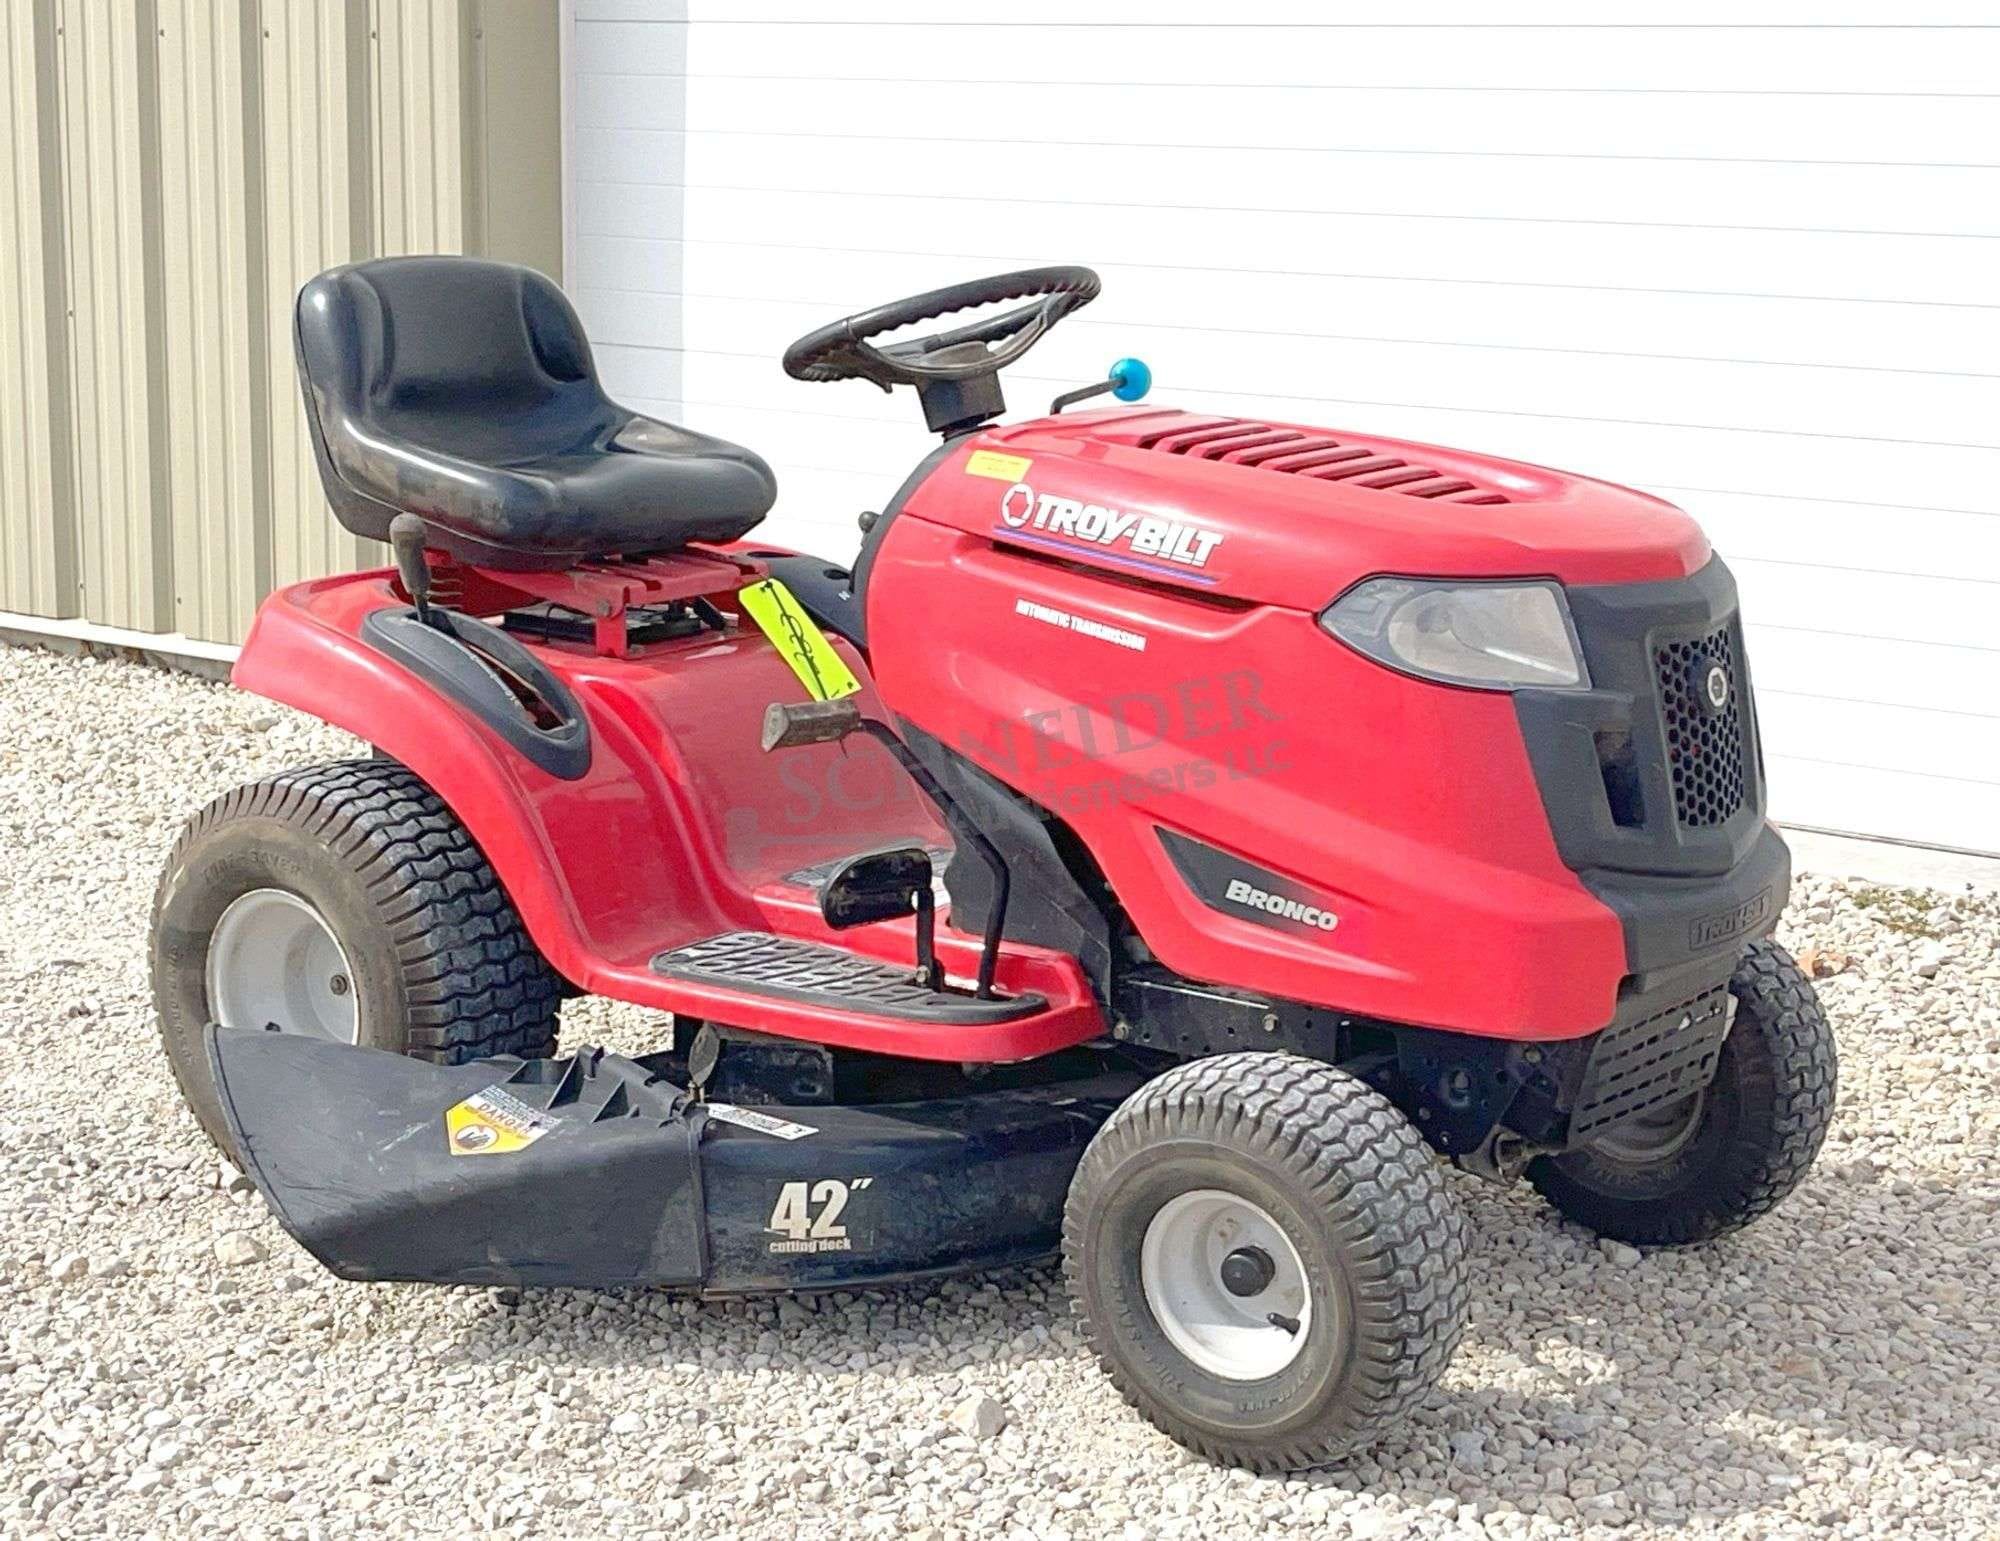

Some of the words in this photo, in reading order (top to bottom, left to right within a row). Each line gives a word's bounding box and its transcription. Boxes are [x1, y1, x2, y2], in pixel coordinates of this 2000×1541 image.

[1032, 493, 1224, 567] TROY-BILT
[1225, 878, 1339, 932] BRONCO
[769, 1238, 818, 1254] cutting
[818, 1236, 852, 1253] deck
